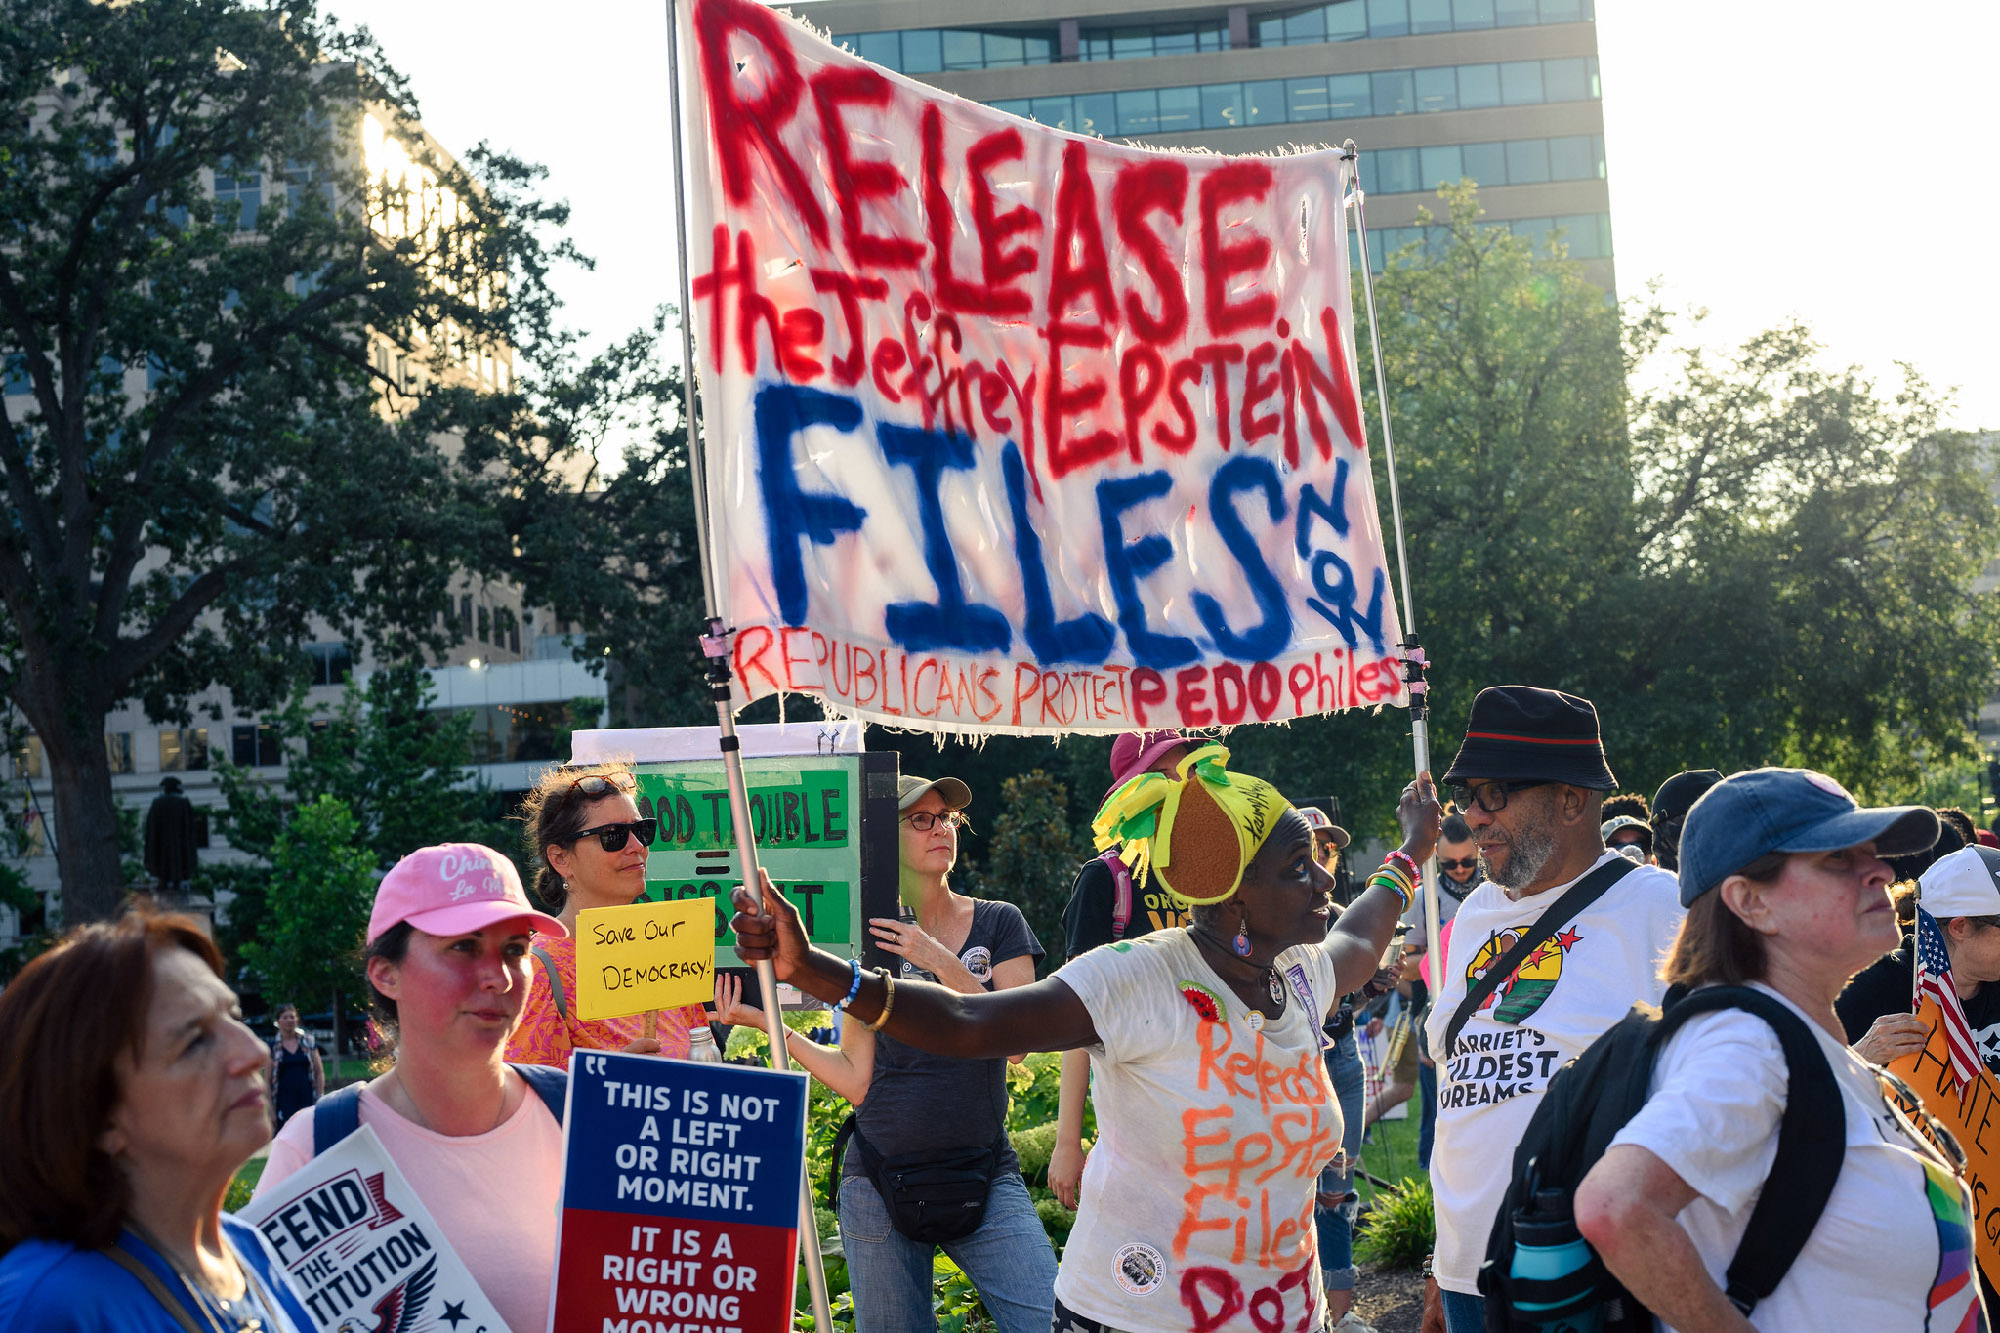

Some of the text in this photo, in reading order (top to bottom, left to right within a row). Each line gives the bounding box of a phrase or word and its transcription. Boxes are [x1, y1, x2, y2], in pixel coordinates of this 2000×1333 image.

[693, 0, 1280, 345] RELEASE
[693, 223, 825, 384] the
[755, 384, 1295, 669] FILES
[1296, 457, 1387, 656] NOW
[733, 625, 1003, 723] REPUBLICANS
[1012, 661, 1131, 727] PROTECT
[593, 920, 686, 946] Save Our
[602, 954, 712, 991] DEMOCRACY!
[1447, 1051, 1560, 1083] ILDEST
[682, 1089, 709, 1115] IS
[720, 1093, 780, 1122] NOT
[639, 1115, 741, 1148] A LEFT
[615, 1144, 761, 1181] OR RIGHT
[617, 1174, 753, 1211] MOMENT.
[631, 1225, 734, 1260] IT IS A
[293, 1251, 339, 1290] THE
[602, 1254, 757, 1292] RIGHT OR
[614, 1286, 740, 1321] WRONG
